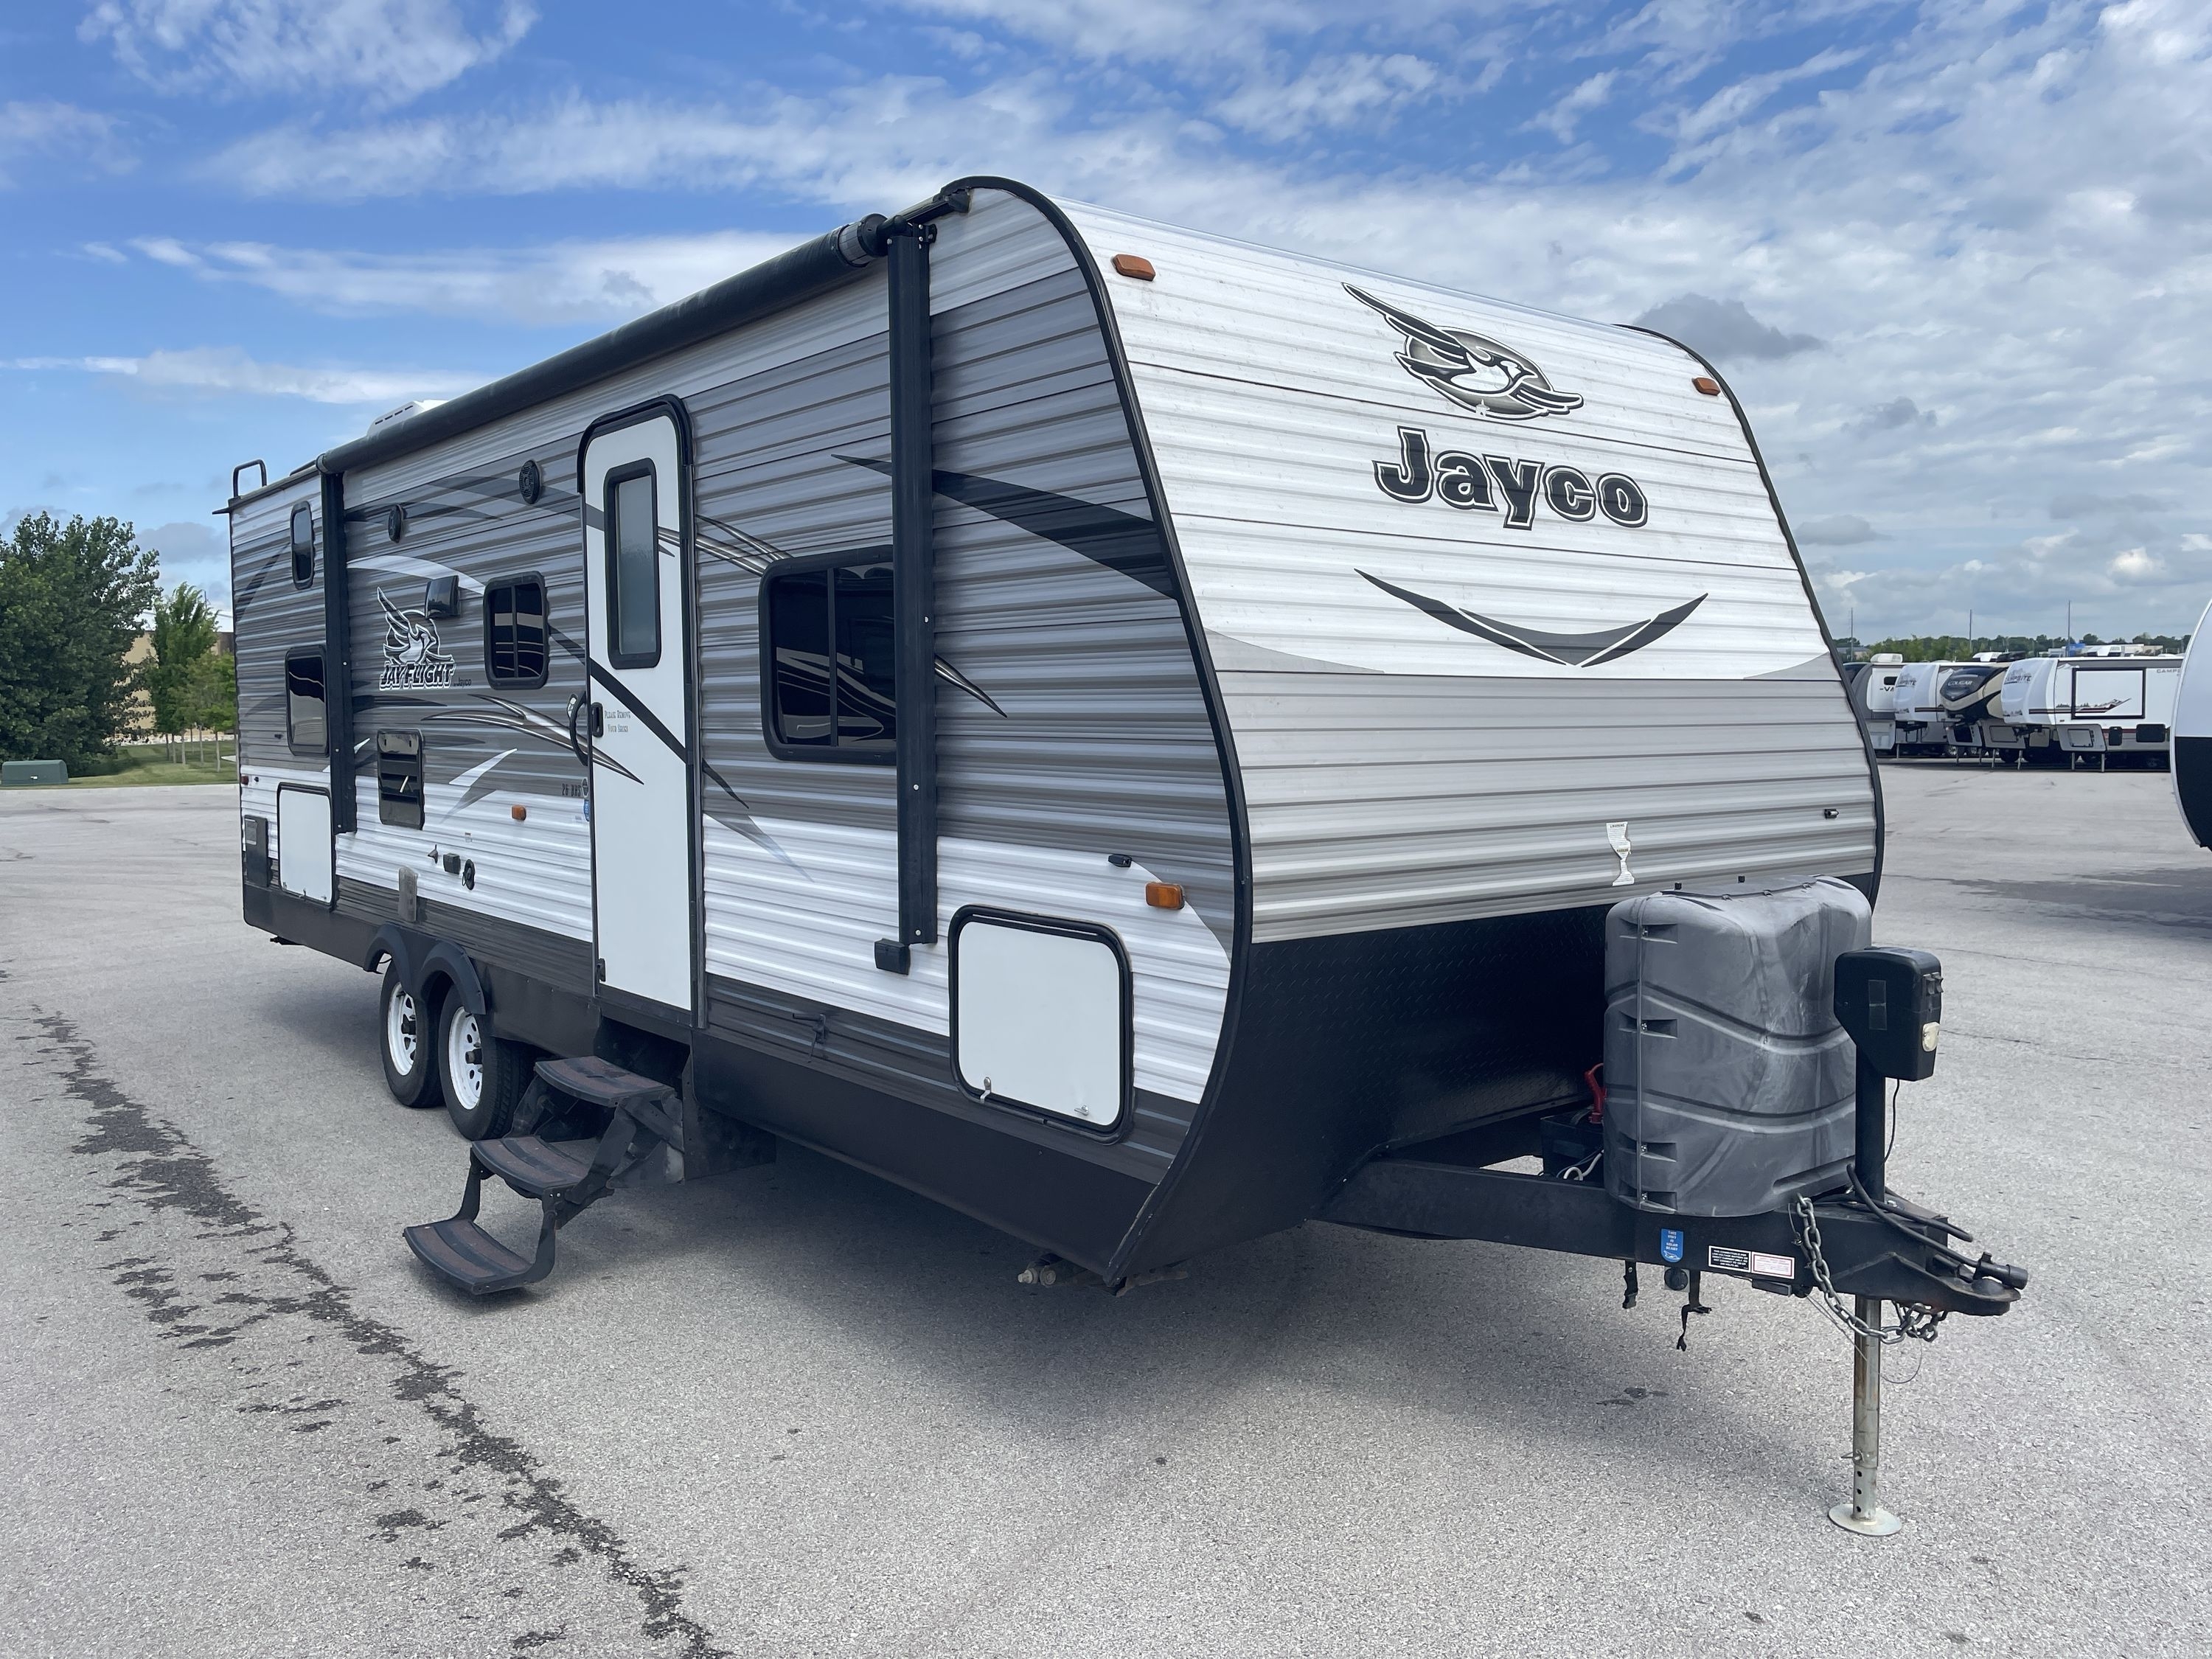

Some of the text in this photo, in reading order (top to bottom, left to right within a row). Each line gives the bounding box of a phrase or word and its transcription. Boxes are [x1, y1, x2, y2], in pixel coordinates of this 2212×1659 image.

[1371, 425, 1649, 531] Jayco
[379, 661, 456, 691] JAY FLIGHT
